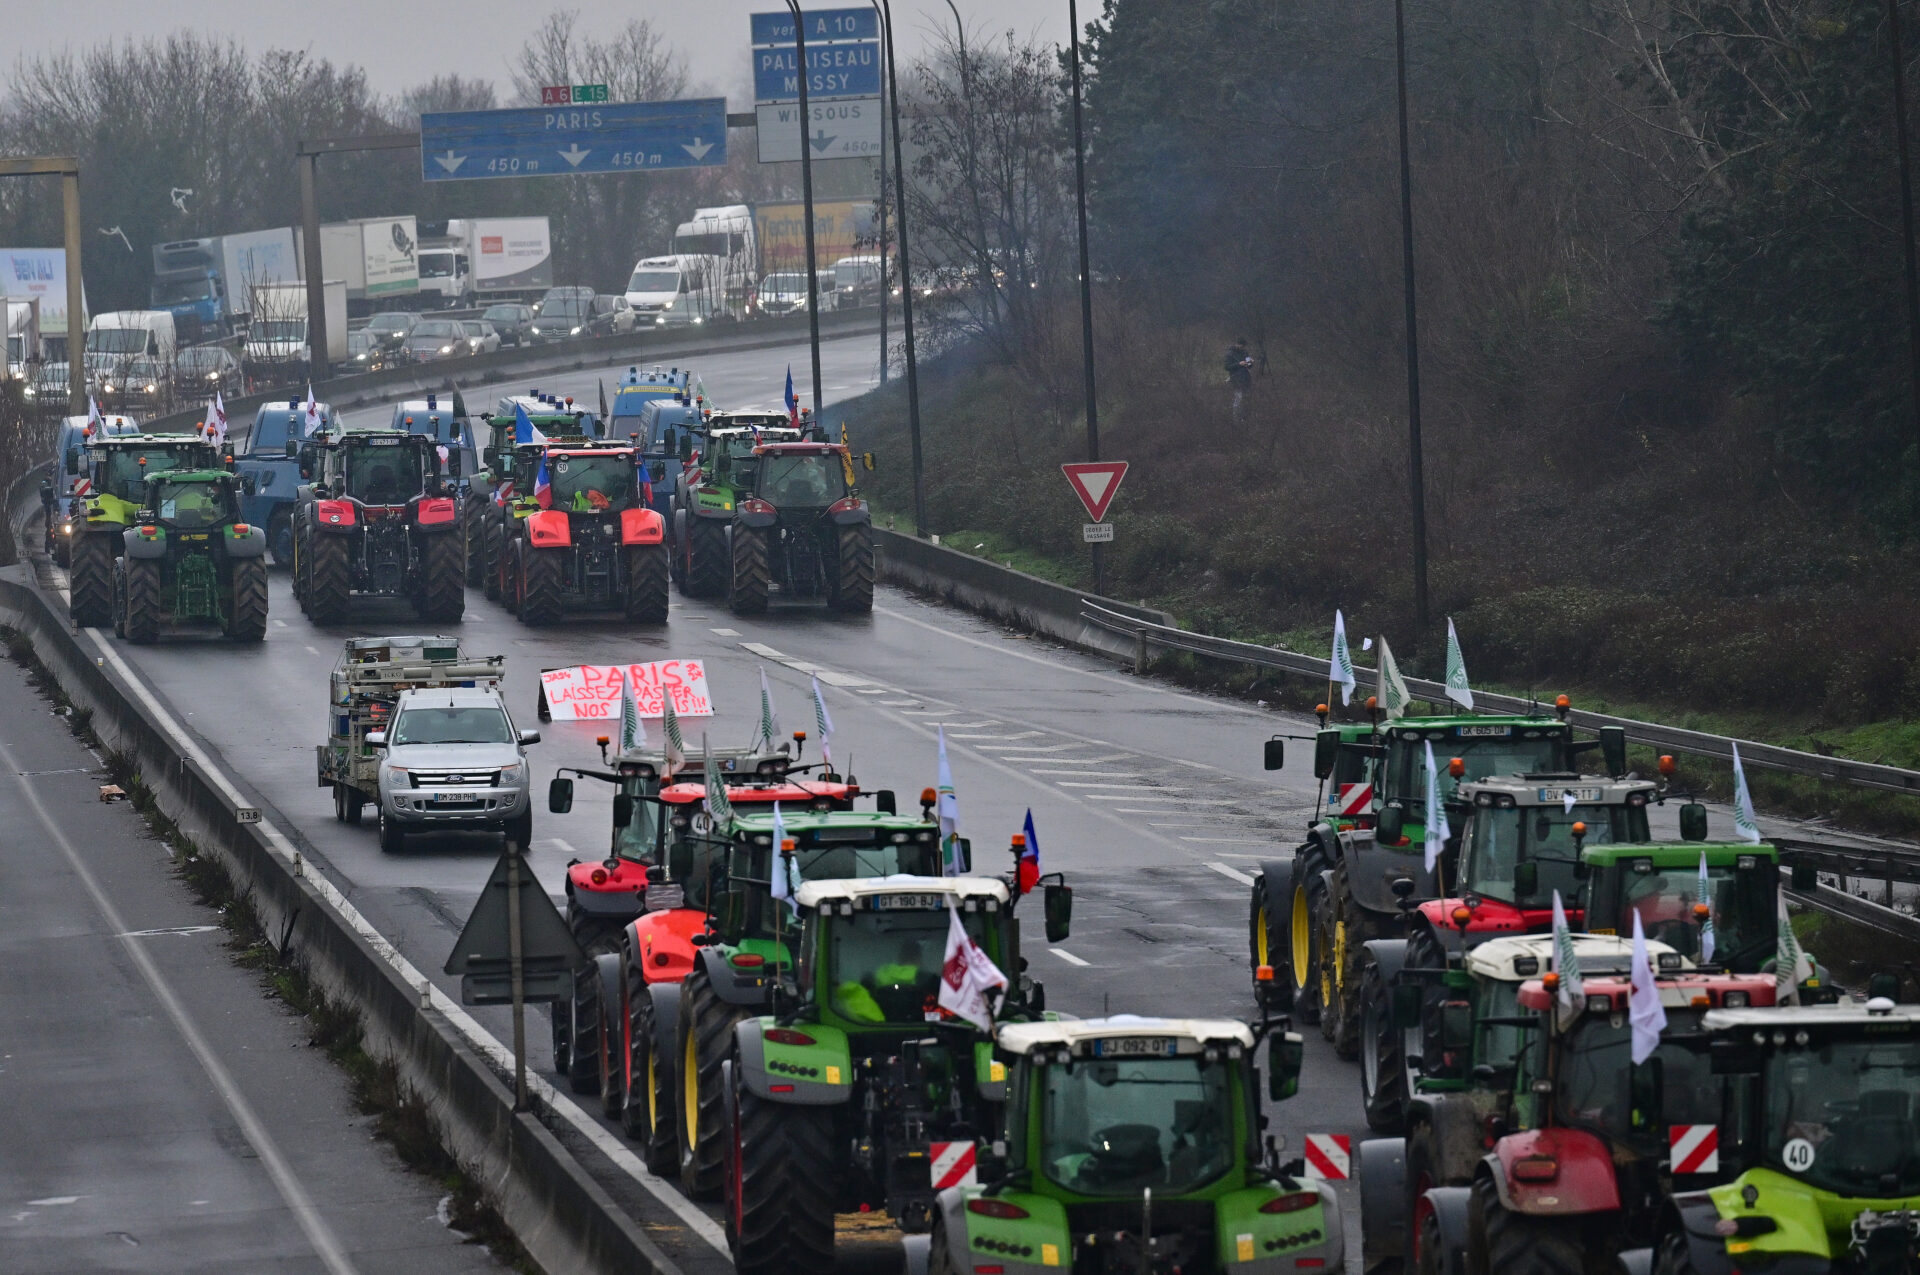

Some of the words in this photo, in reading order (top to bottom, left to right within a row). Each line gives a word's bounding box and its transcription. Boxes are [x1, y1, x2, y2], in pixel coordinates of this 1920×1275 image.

[816, 17, 827, 35] A
[834, 15, 856, 33] 10
[545, 89, 553, 101] A
[559, 88, 568, 101] 6
[575, 87, 582, 100] E
[589, 86, 605, 100] 15
[545, 111, 603, 129] PARIS
[778, 105, 861, 123] WISOUS
[488, 158, 520, 172] 450
[526, 160, 539, 172] m
[611, 151, 644, 165] 450
[649, 153, 662, 165] m
[558, 463, 567, 472] 50
[580, 660, 683, 689] PARIS
[573, 702, 611, 718] NOS
[696, 816, 710, 831] 40
[1789, 1144, 1809, 1166] 40
